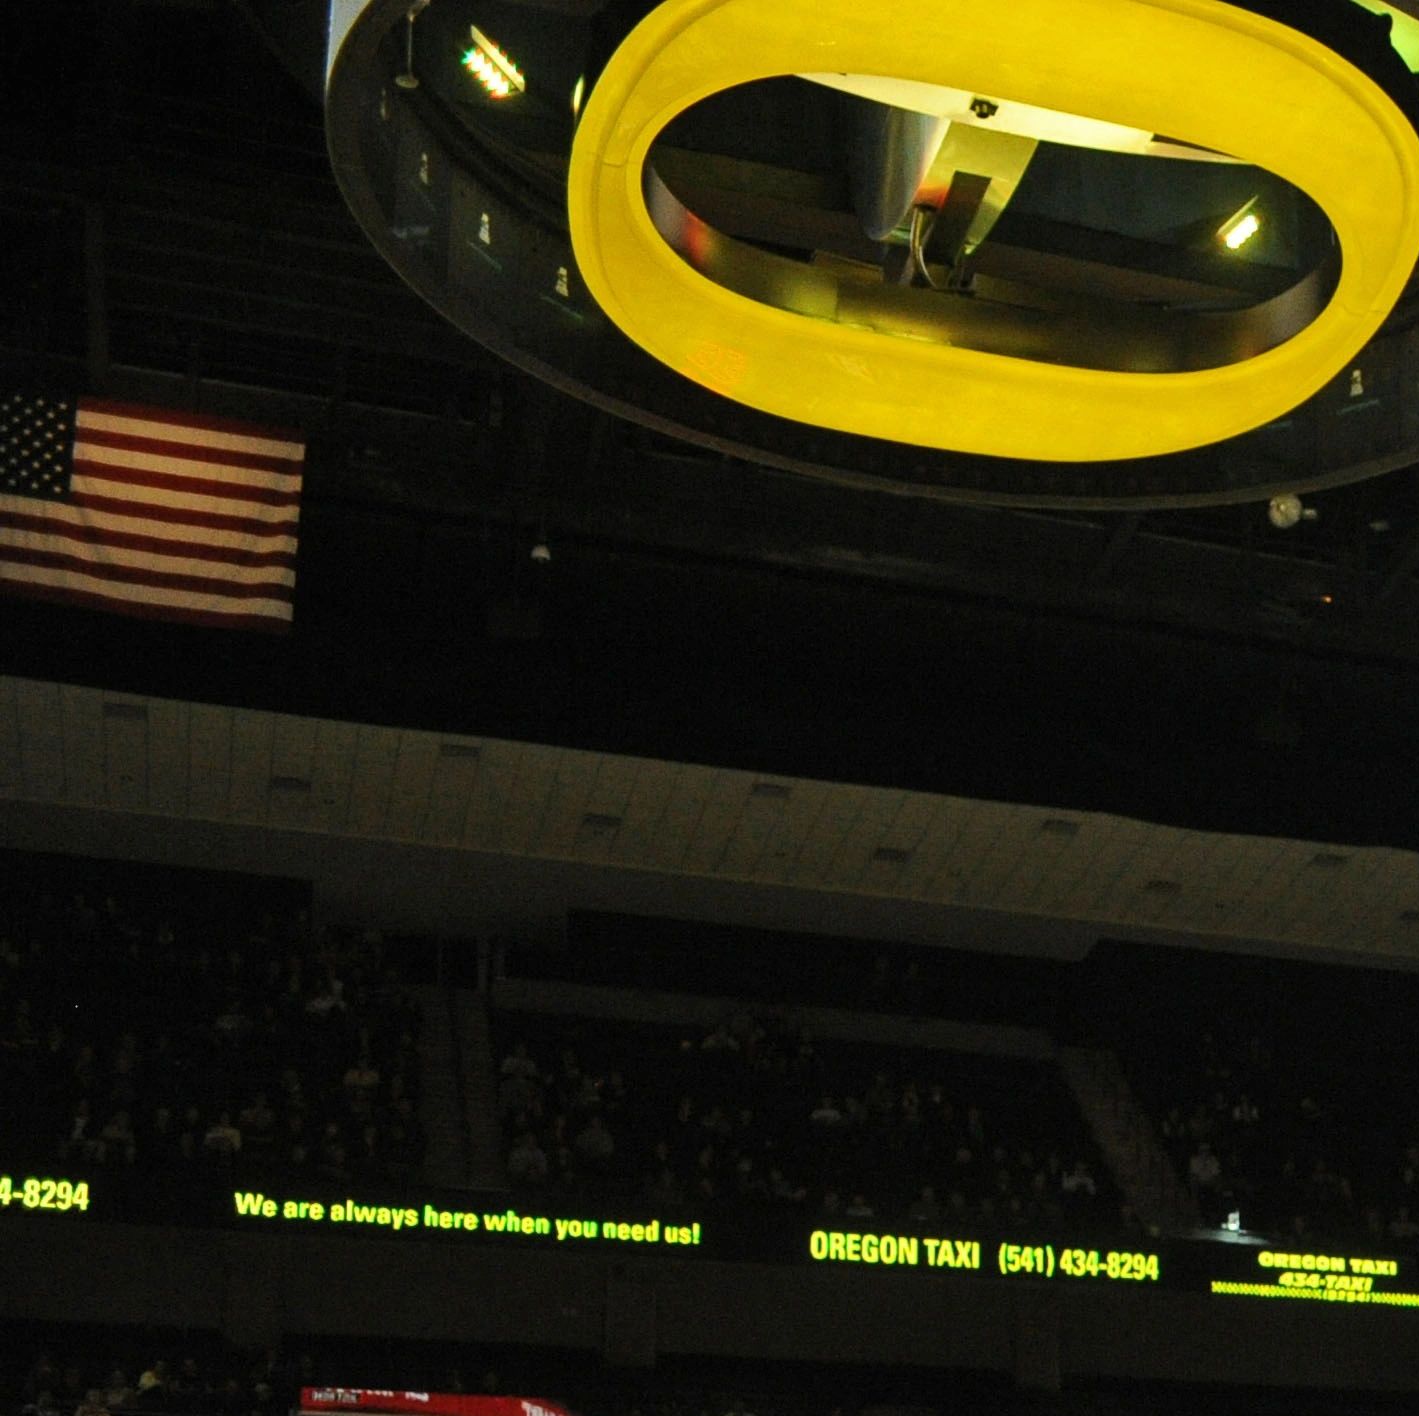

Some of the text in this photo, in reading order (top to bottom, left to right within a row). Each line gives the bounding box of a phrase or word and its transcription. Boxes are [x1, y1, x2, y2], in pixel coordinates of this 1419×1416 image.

[235, 1192, 700, 1244] We are always here when you need us!
[809, 1231, 1159, 1281] OREGON TAXI (541) 434-8294
[1258, 1251, 1398, 1276] OREGON TAXI
[1279, 1272, 1373, 1292] 434-TAXI
